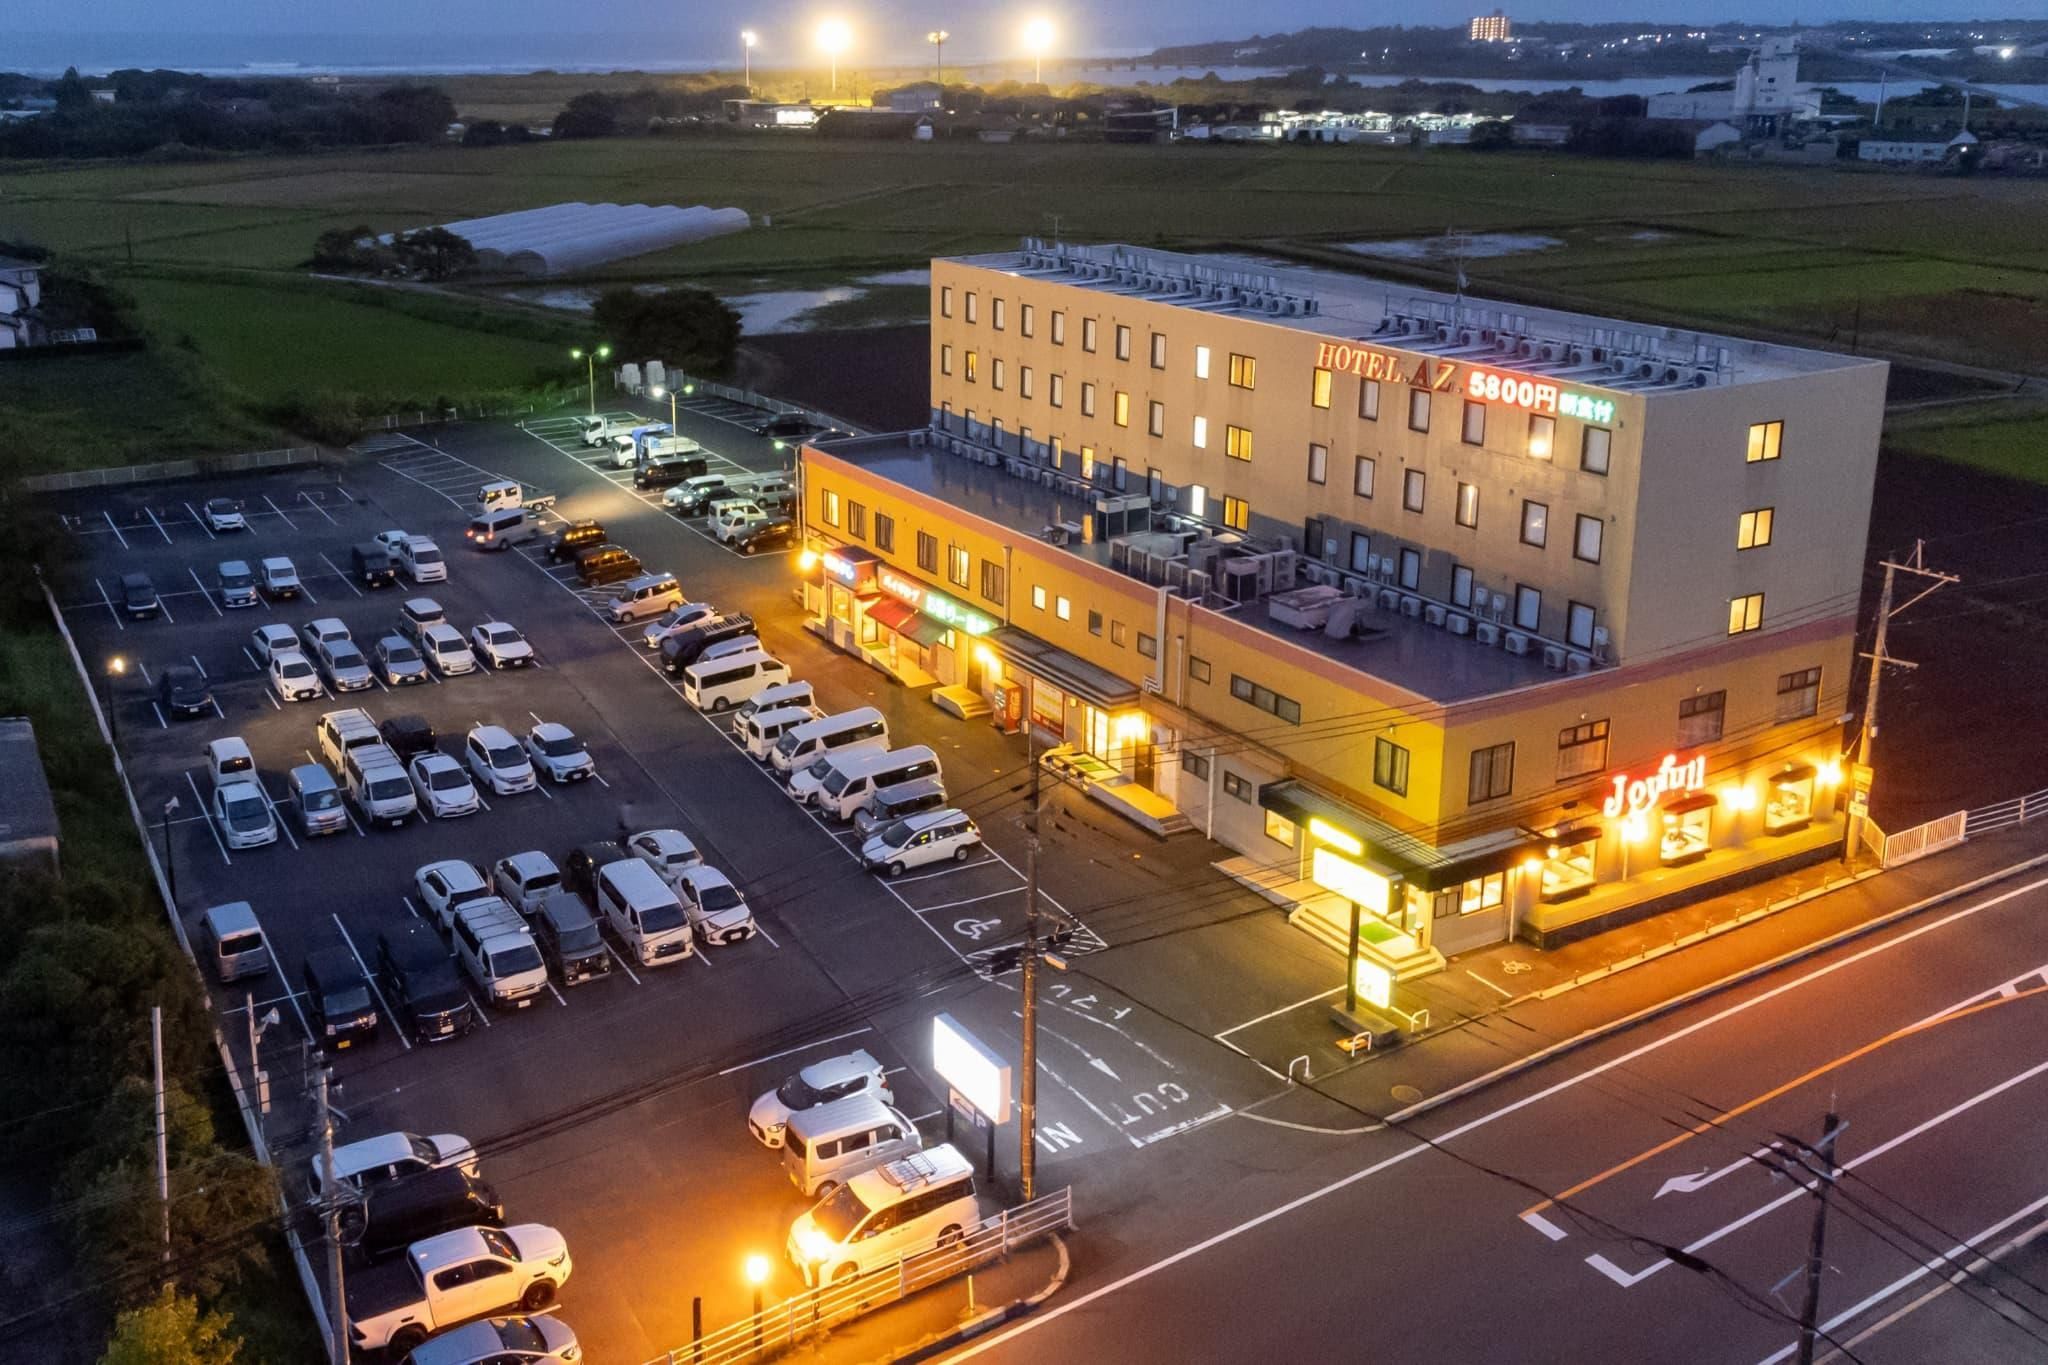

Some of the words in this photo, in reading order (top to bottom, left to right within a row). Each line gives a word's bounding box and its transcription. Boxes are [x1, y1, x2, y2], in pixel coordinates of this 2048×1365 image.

[1317, 342, 1401, 383] HOTEL
[1408, 359, 1457, 393] AZ
[1603, 753, 1705, 818] Joyfull
[1035, 1121, 1083, 1153] IN
